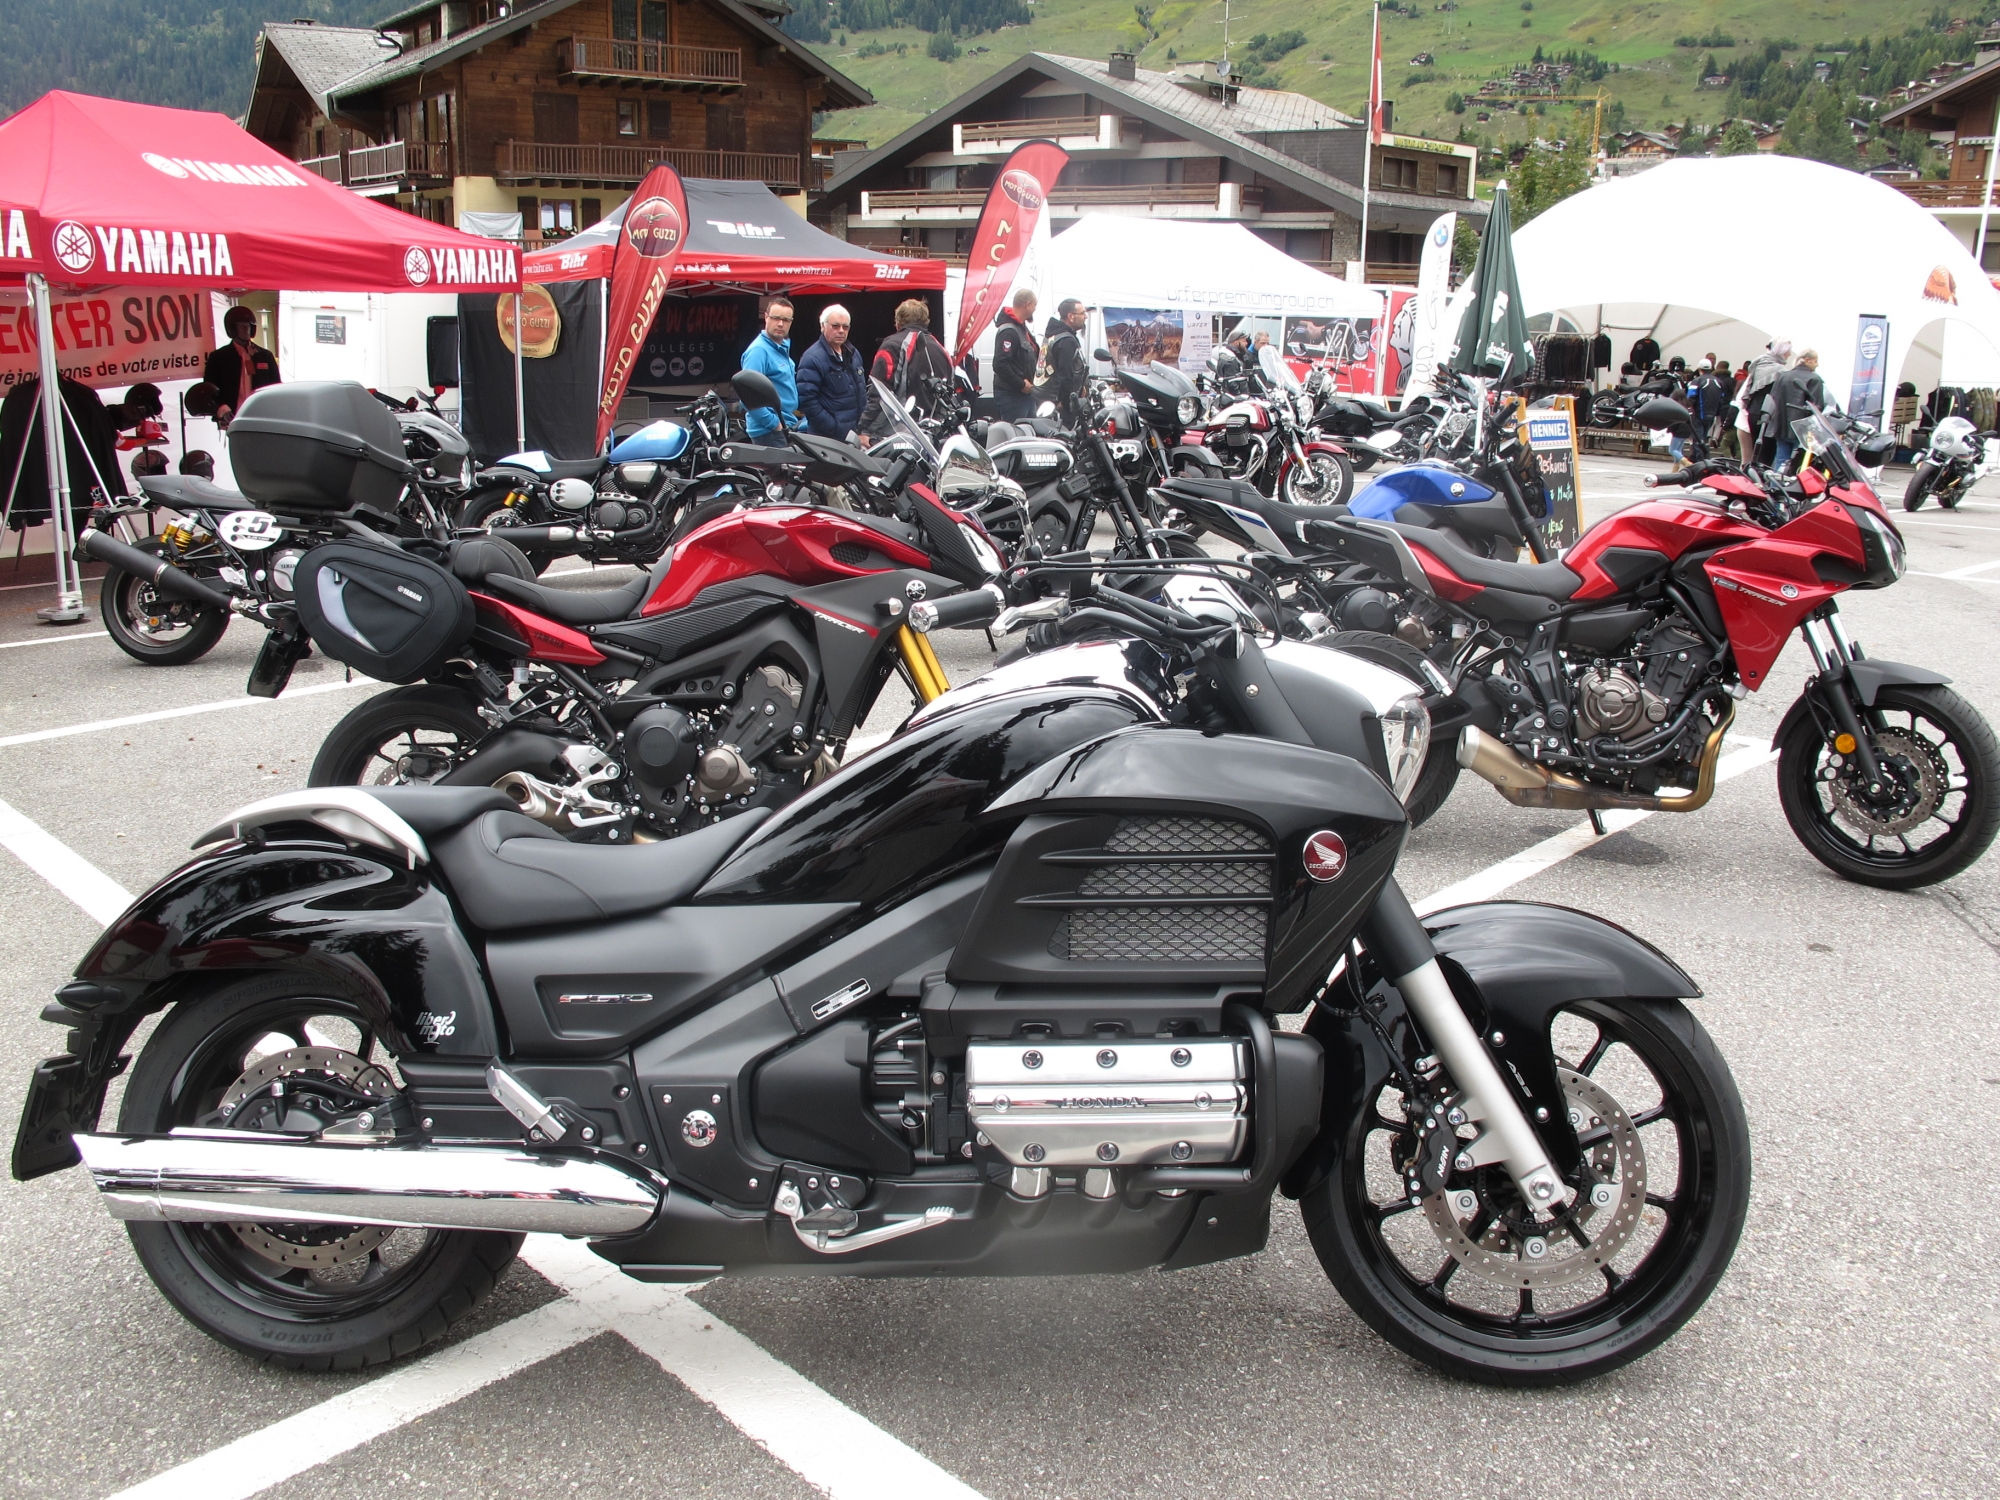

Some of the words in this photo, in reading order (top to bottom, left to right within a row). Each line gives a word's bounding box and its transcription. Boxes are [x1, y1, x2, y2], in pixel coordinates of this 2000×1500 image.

[172, 157, 309, 187] YAMAHA
[652, 227, 677, 241] GUZZI
[706, 219, 777, 237] Bihr
[95, 225, 234, 276] YAMAHA
[558, 252, 588, 270] Bihr
[430, 248, 518, 284] YAMAHA
[776, 266, 832, 276] www.bihr.eu
[873, 263, 910, 280] Bihr
[1167, 285, 1334, 311] urferpremiumgroup.ch
[123, 293, 203, 345] SION
[529, 316, 551, 329] GUZZI
[600, 347, 632, 415] MOTO
[630, 266, 668, 345] GUZZI
[96, 361, 118, 377] de
[121, 357, 160, 373] votre
[162, 352, 200, 369] viste
[1531, 422, 1568, 438] HENNIEZ
[1025, 454, 1058, 463] YAMAHA
[402, 587, 423, 603] YAMAHA
[1738, 585, 1788, 607] TRACER
[814, 610, 866, 634] TRACER
[533, 630, 565, 650] YAMAHA
[1505, 1058, 1534, 1098] ABS
[1061, 1096, 1147, 1108] HONDA
